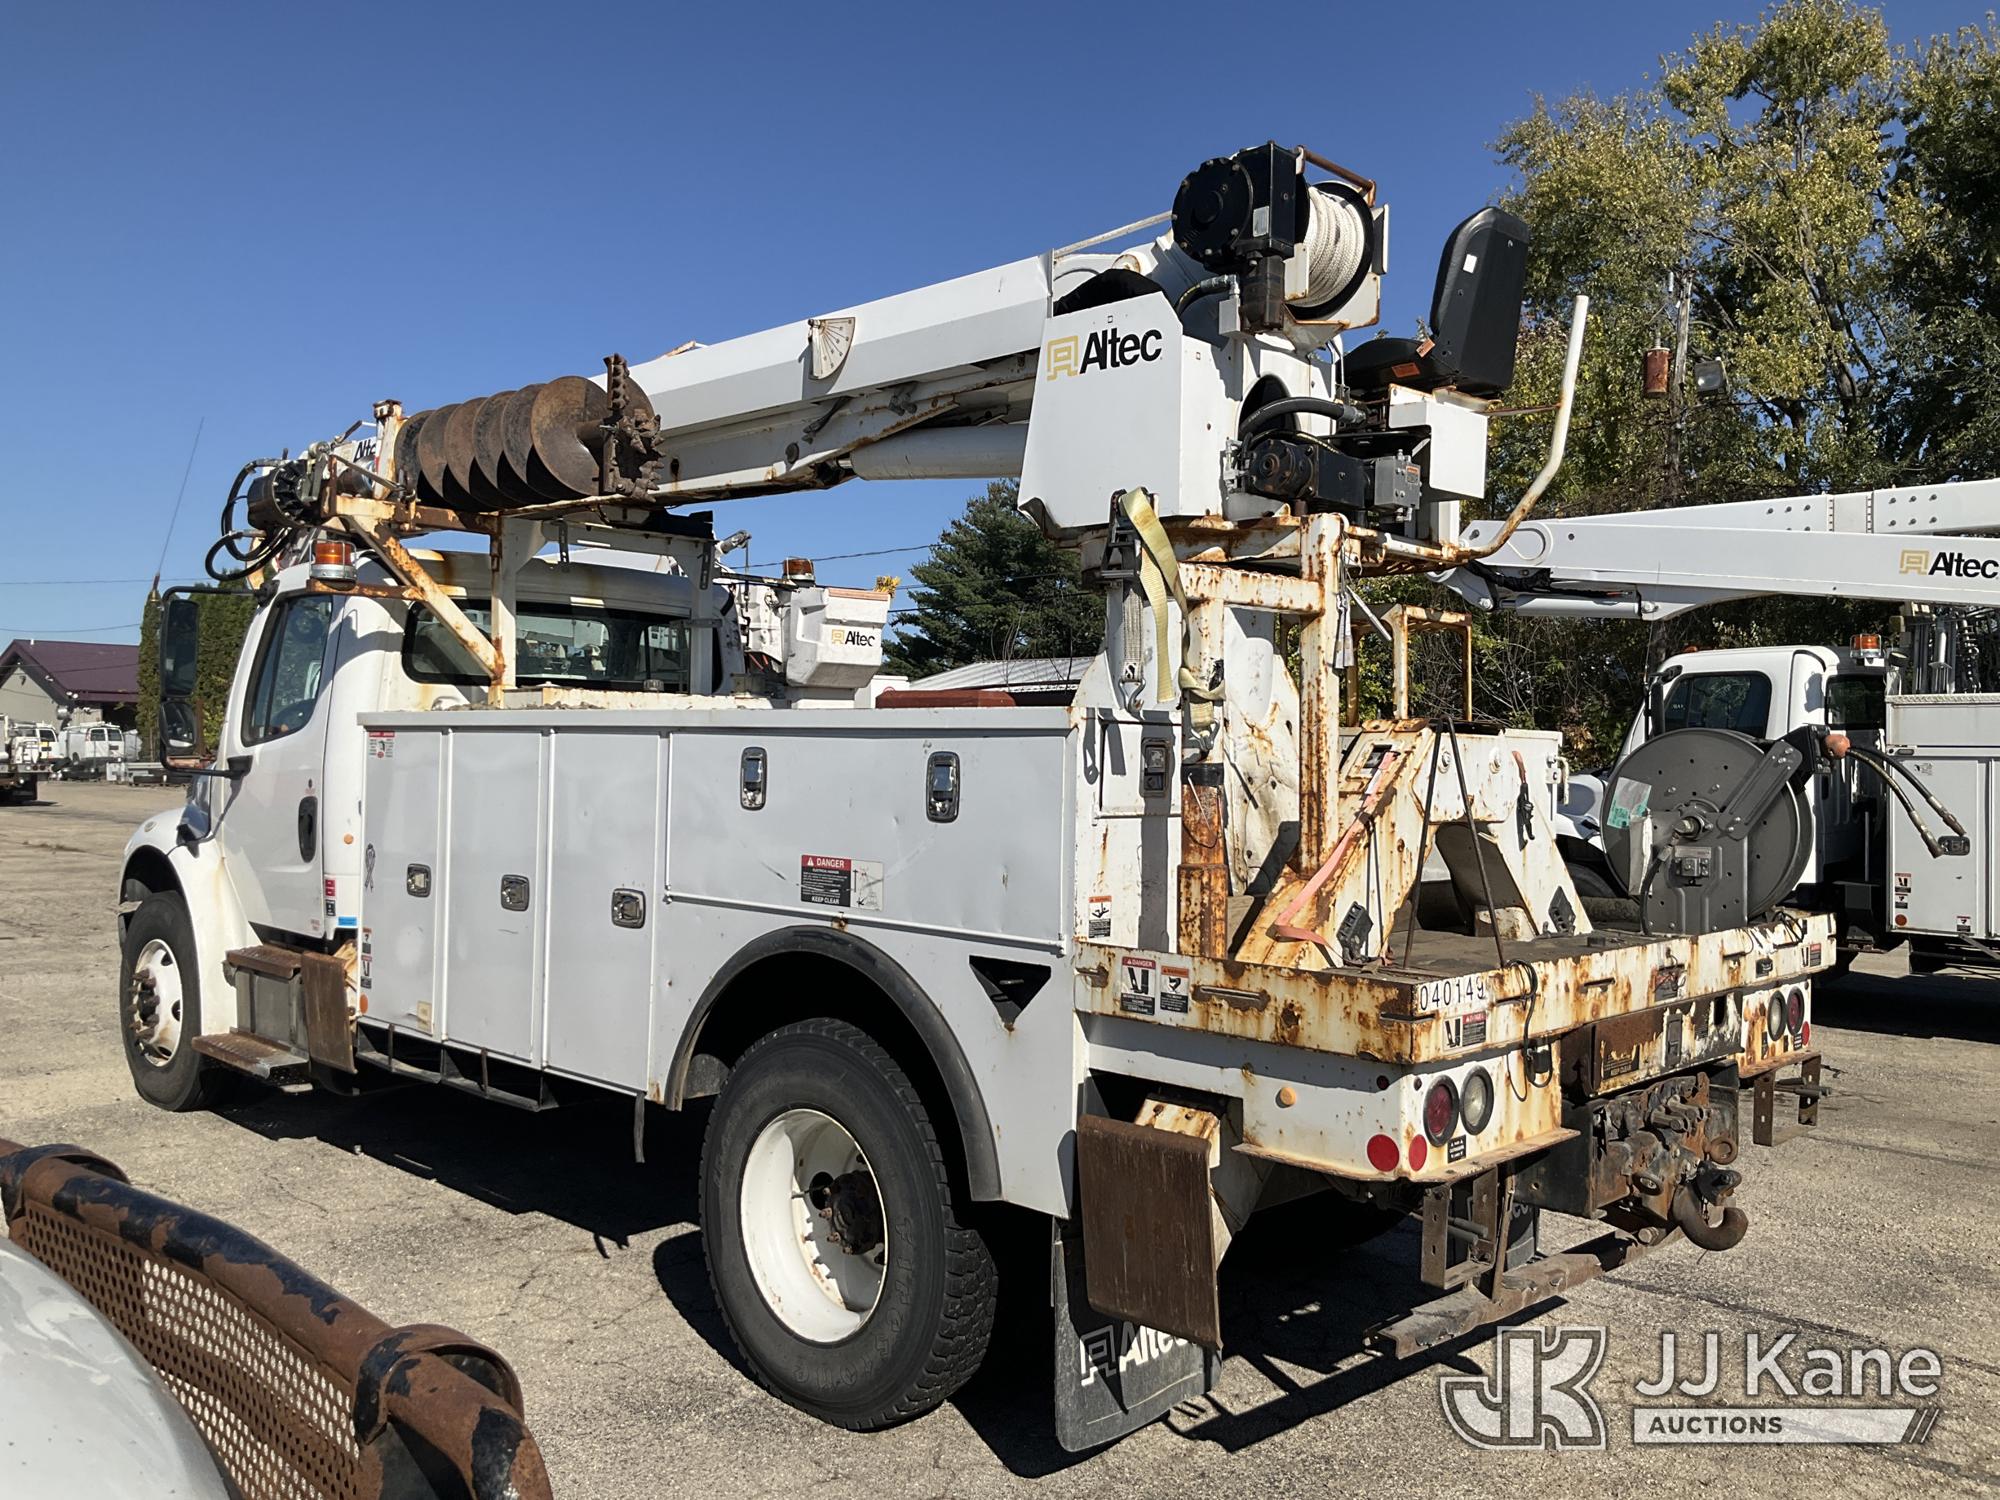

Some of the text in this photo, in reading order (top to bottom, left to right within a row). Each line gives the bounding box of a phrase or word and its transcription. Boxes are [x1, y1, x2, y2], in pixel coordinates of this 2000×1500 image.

[1079, 327, 1163, 375] Altec
[353, 439, 376, 463] Alte
[1928, 552, 1999, 579] Altec
[844, 631, 876, 647] Altec
[816, 857, 845, 868] DANGER
[811, 895, 840, 905] KEEP CLEAR
[1420, 976, 1486, 1011] 040149
